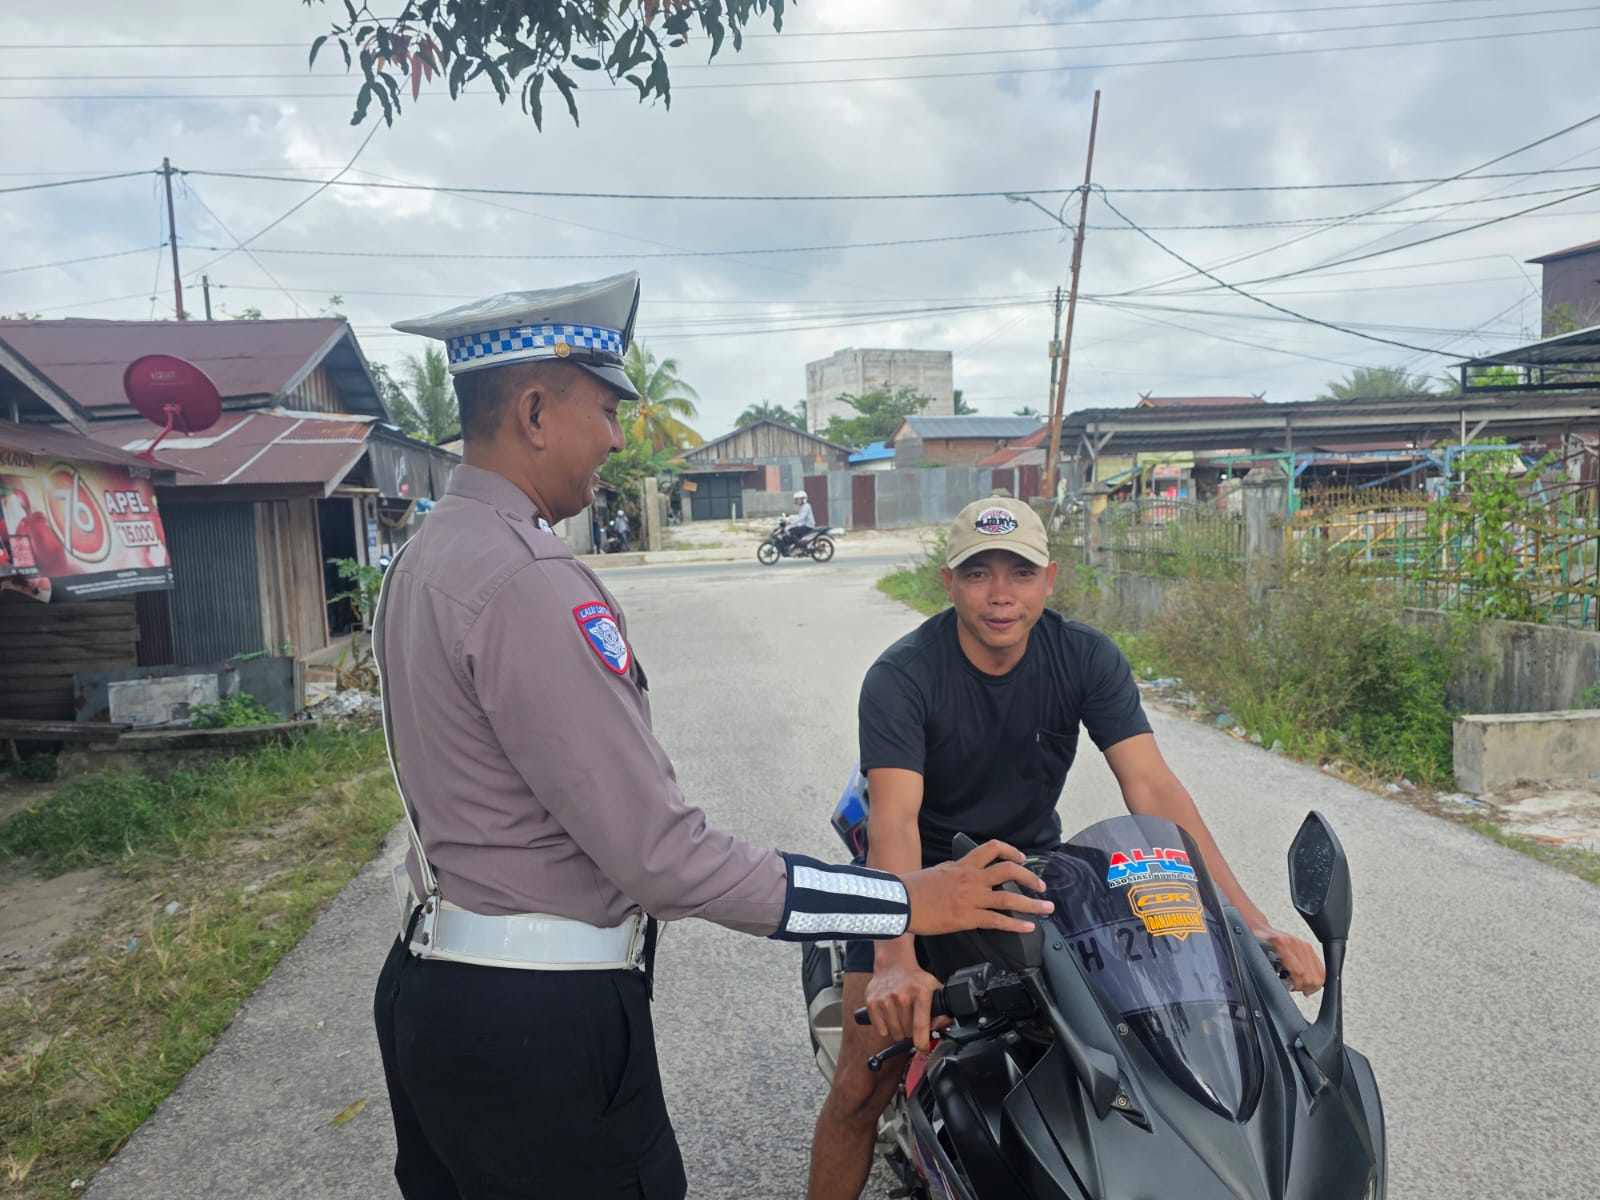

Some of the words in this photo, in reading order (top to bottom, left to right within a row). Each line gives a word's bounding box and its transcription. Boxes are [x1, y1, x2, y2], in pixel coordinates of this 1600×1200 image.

[55, 472, 96, 553] 76
[104, 491, 149, 514] APEL
[1137, 893, 1194, 907] CBR
